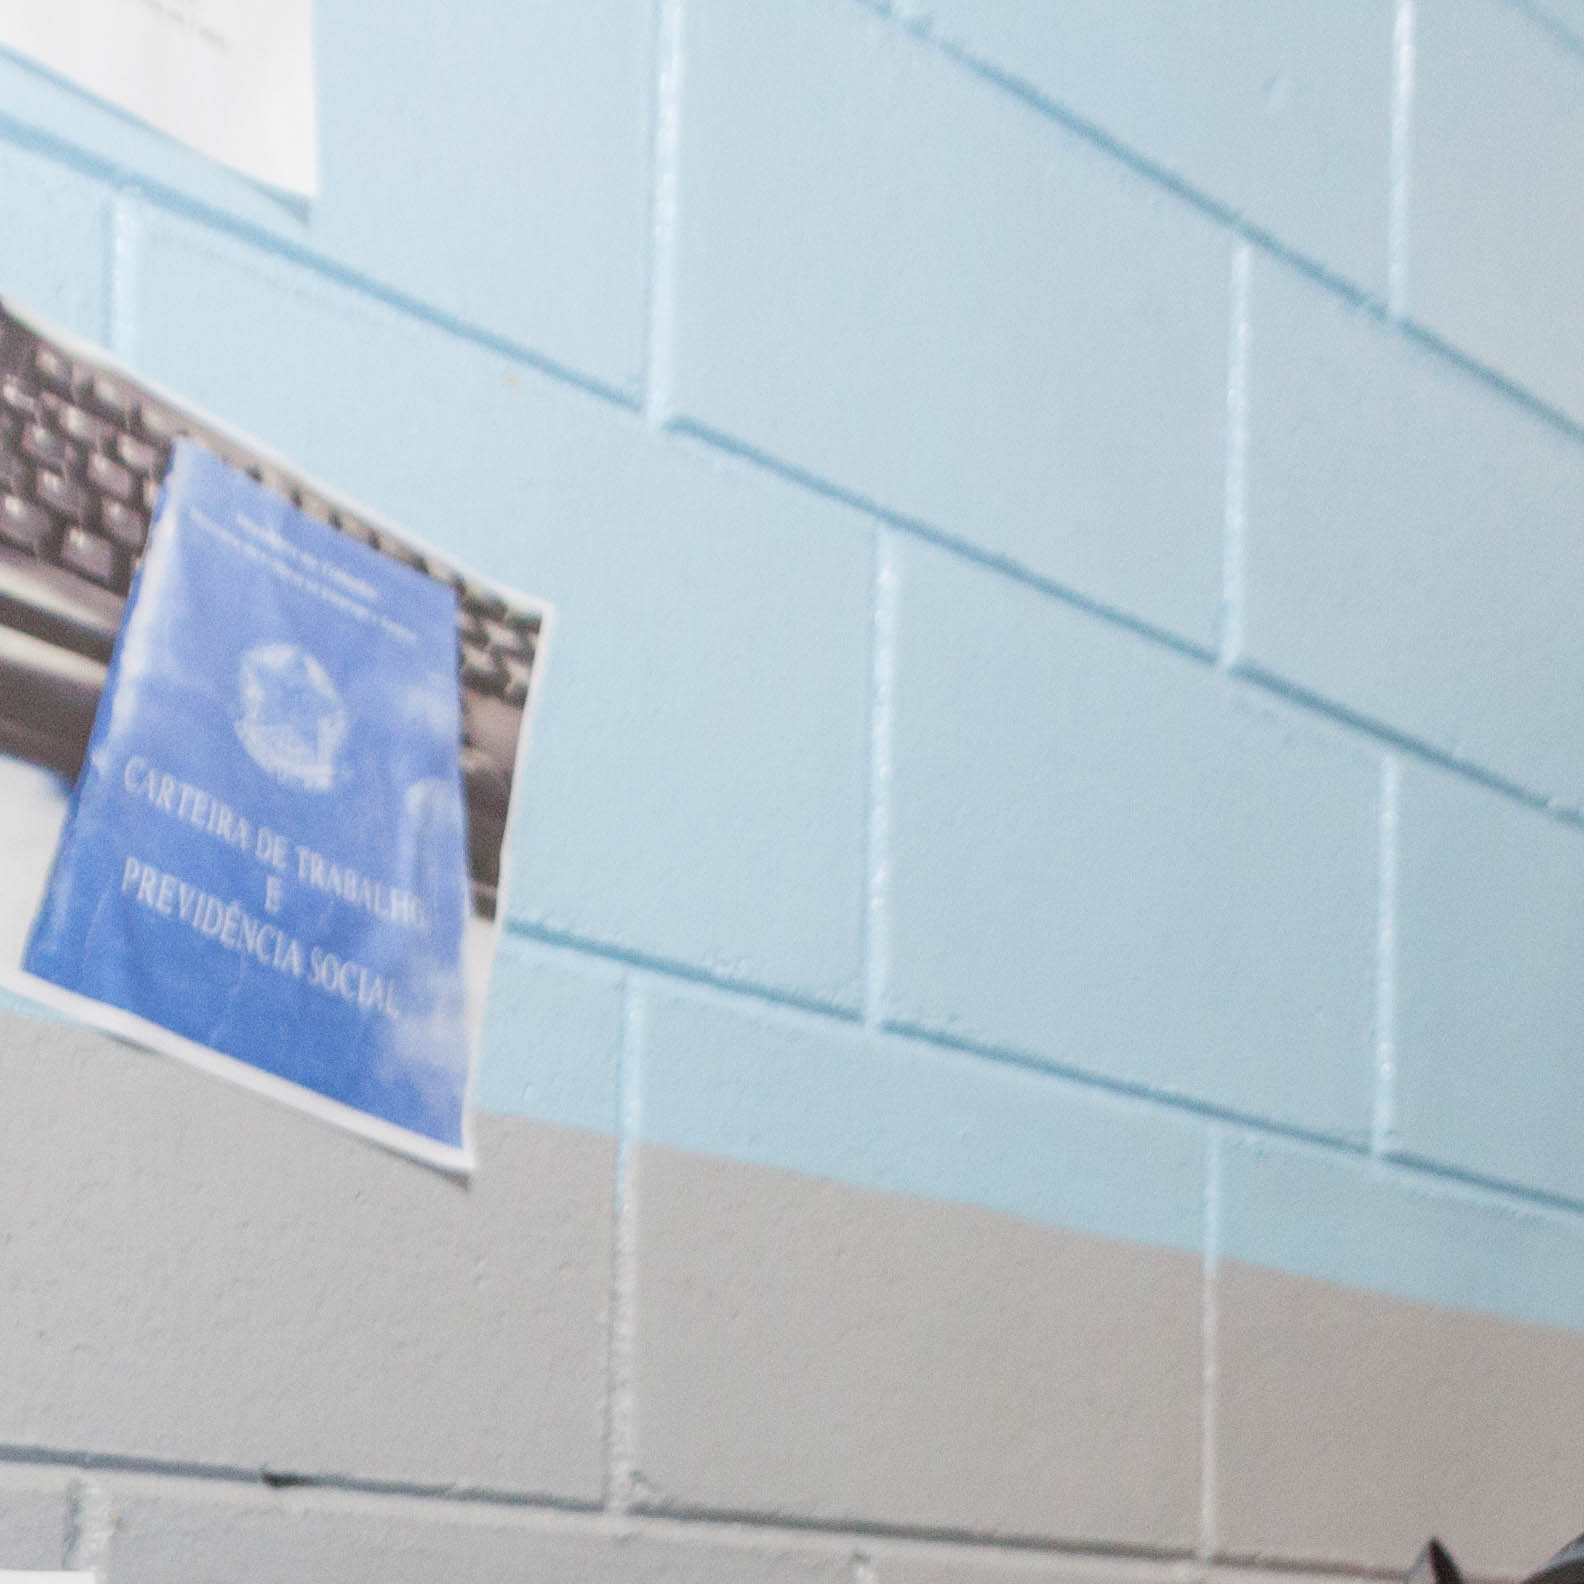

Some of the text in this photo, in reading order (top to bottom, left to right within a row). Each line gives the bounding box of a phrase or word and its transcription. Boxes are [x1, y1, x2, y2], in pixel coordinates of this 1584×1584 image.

[123, 754, 427, 928] CARTEIRA DE TRABALHO
[266, 876, 282, 914] E
[121, 855, 402, 1018] PREVIDÊNCIA SOCIAL
